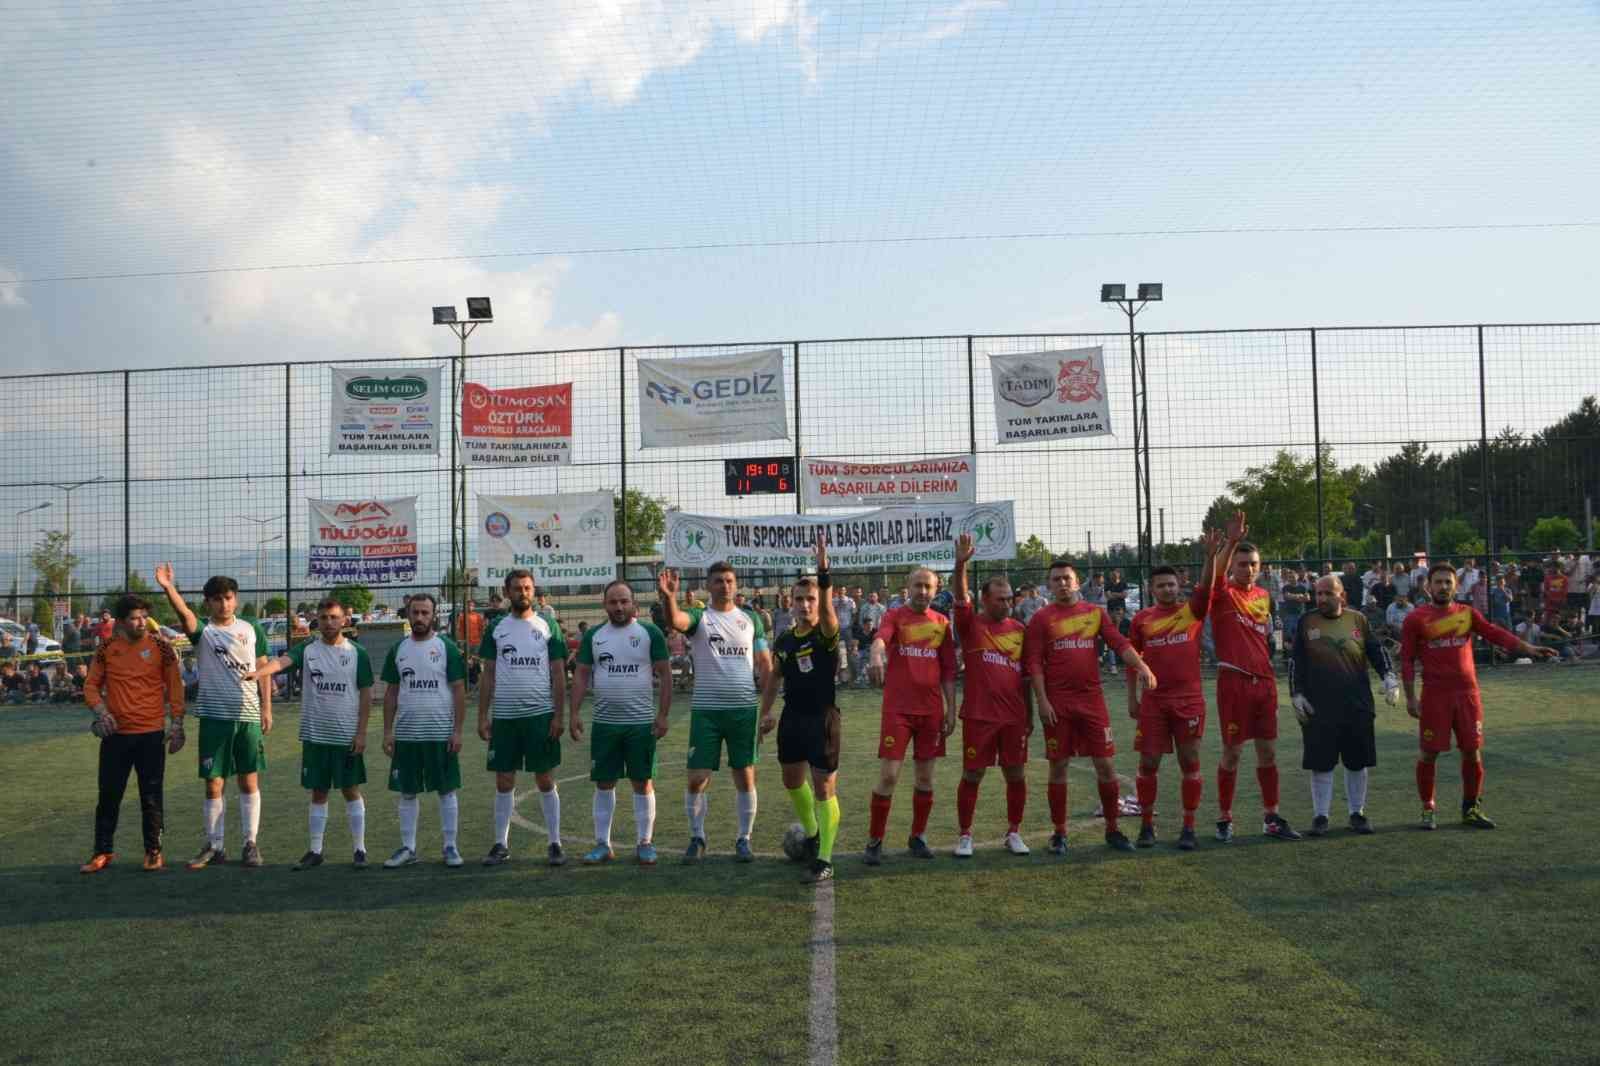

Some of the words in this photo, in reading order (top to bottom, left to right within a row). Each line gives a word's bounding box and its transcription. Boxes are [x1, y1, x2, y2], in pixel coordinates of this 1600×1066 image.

[392, 384, 420, 393] GIDA
[694, 372, 777, 400] GEDİZ
[488, 410, 545, 424] ÖZTÜRK
[1008, 417, 1032, 426] TÜM
[1034, 411, 1099, 424] TAKIMLARA
[342, 432, 365, 440] TÜM
[1005, 427, 1068, 439] BAŞARILAR
[1070, 423, 1103, 433] DİLER
[338, 443, 399, 451] BAŞARILAR
[471, 454, 529, 463] BAŞARILAR
[530, 453, 560, 462] DİLER
[808, 463, 838, 475] TÜM
[842, 461, 970, 476] SPORCULARIMIZA
[820, 480, 896, 497] BAŞARILAR
[901, 477, 958, 494] DİLERİM
[723, 519, 751, 547] TÜM
[837, 518, 904, 551] BAŞARILAR
[907, 511, 953, 543] DİLERİZ
[534, 534, 560, 548] 18.
[514, 552, 544, 565] Halı
[547, 553, 584, 565] Saha
[762, 554, 807, 566] AMATÖR
[842, 551, 904, 565] KULÜPLERİ
[538, 566, 612, 578] Turnuvası
[510, 657, 541, 666] HAYAT
[608, 664, 640, 673] HAYAT
[409, 679, 439, 689] HAYAT
